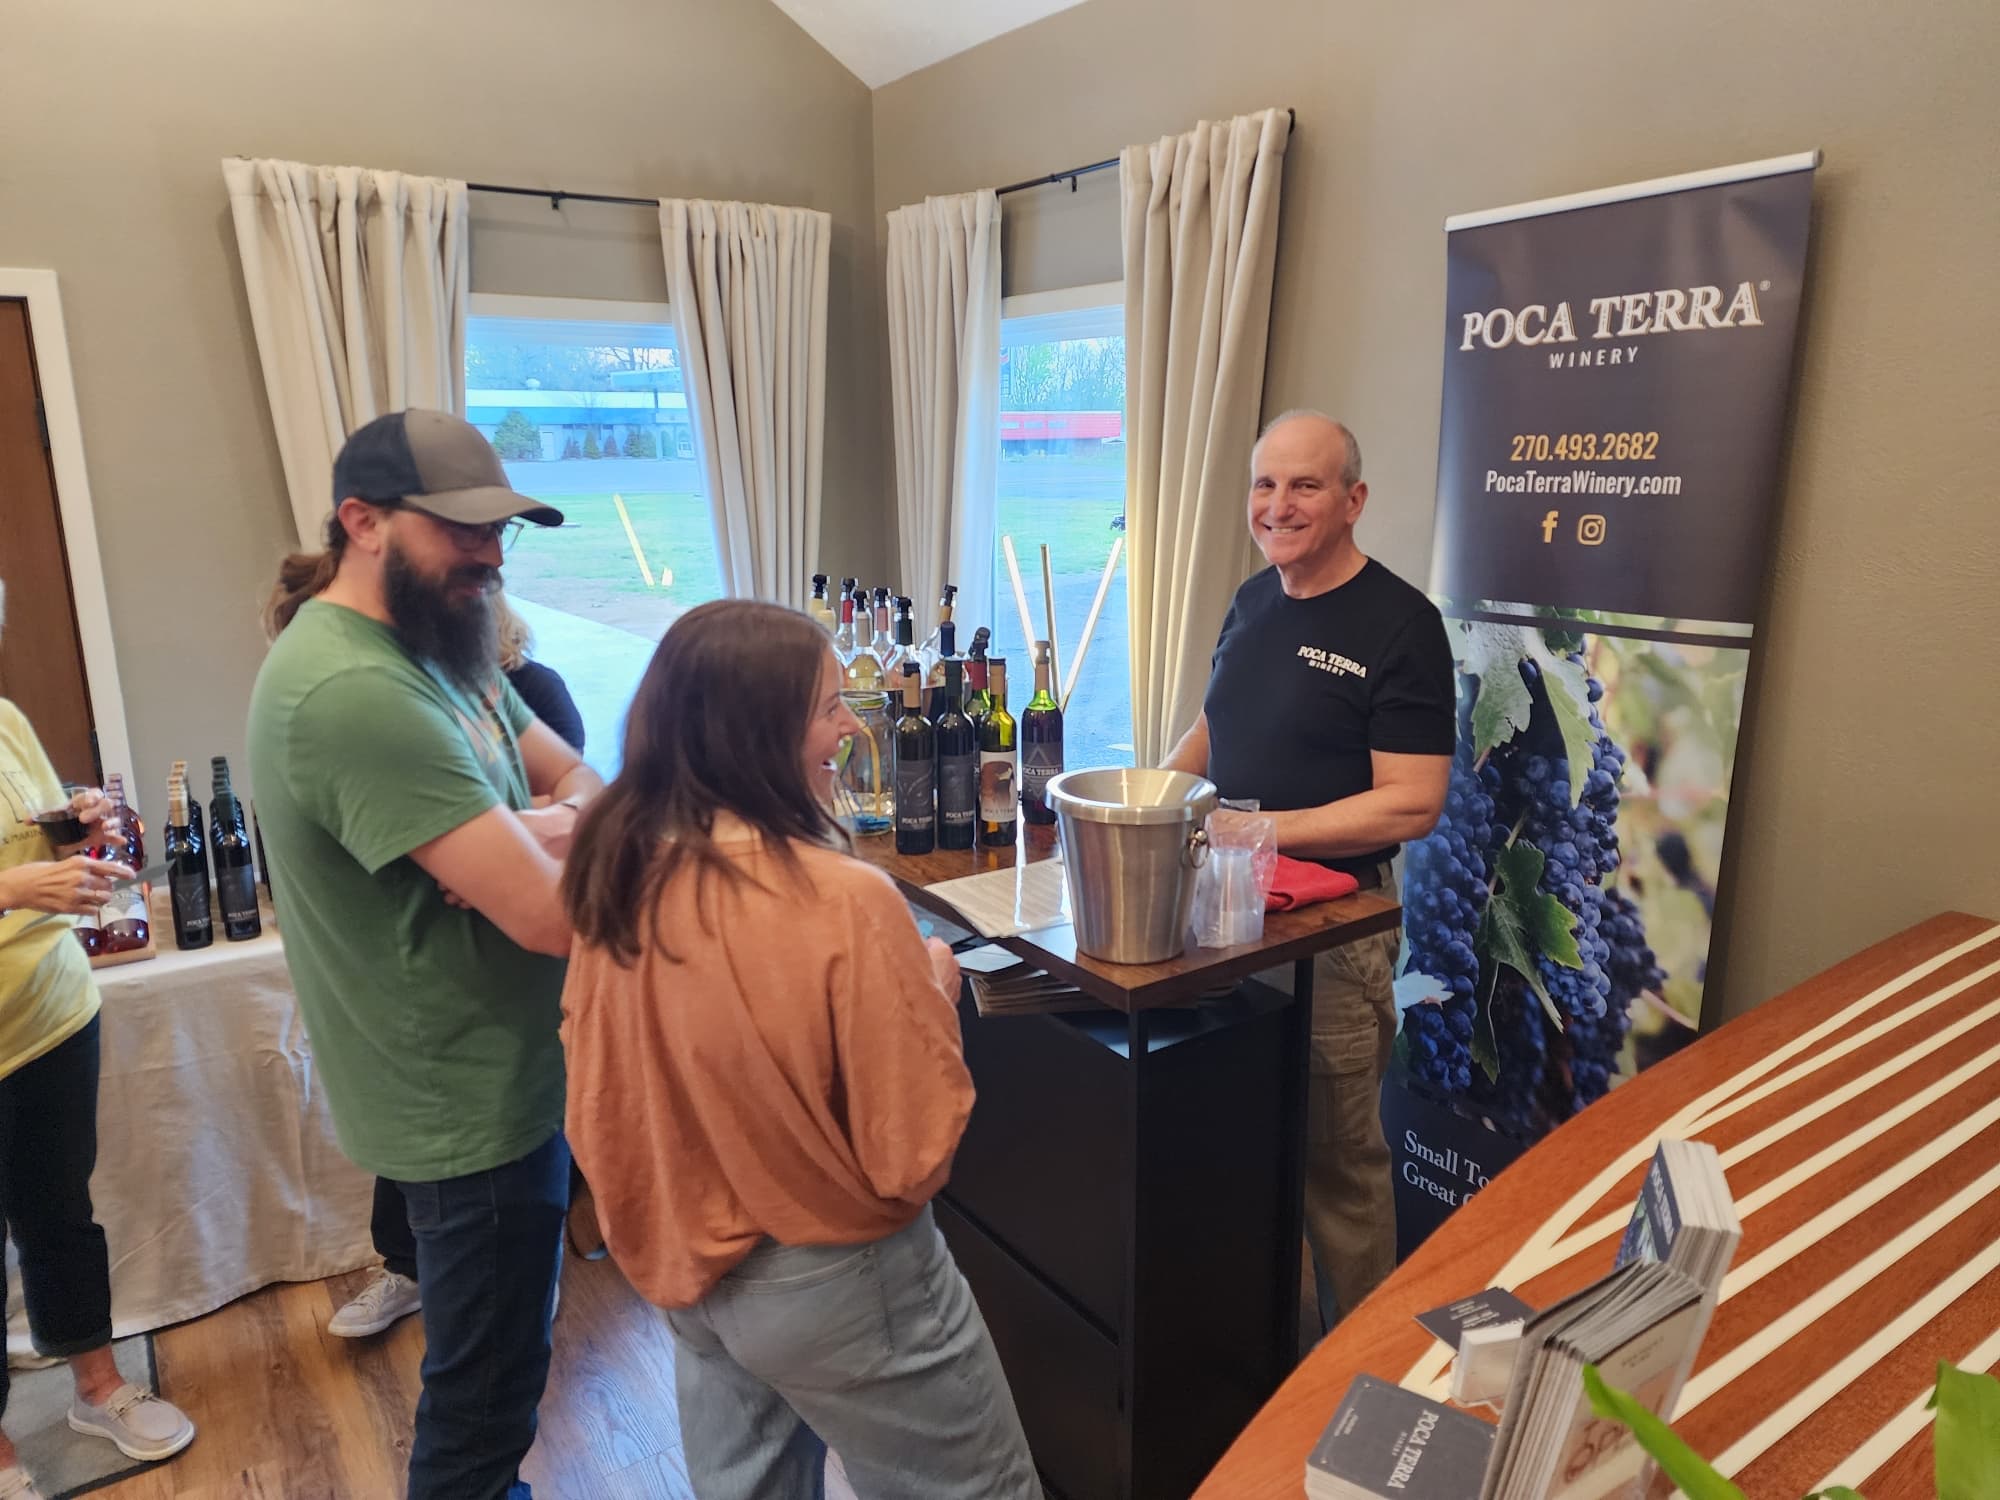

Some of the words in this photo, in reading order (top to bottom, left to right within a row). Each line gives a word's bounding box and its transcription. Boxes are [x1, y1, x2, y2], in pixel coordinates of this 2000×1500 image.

[1459, 301, 1578, 351] POCA
[1549, 346, 1639, 369] WINERY
[1510, 431, 1660, 461] 270.493.2682
[1484, 469, 1683, 498] PocaTerraWinery.com
[1297, 645, 1327, 662] POCA
[1327, 652, 1367, 679] TERRA
[1404, 1129, 1459, 1176] Small
[1464, 1158, 1490, 1190] To
[1403, 1161, 1458, 1206] Great
[1409, 1409, 1440, 1446] POCA
[1386, 1445, 1423, 1489] TERRA
